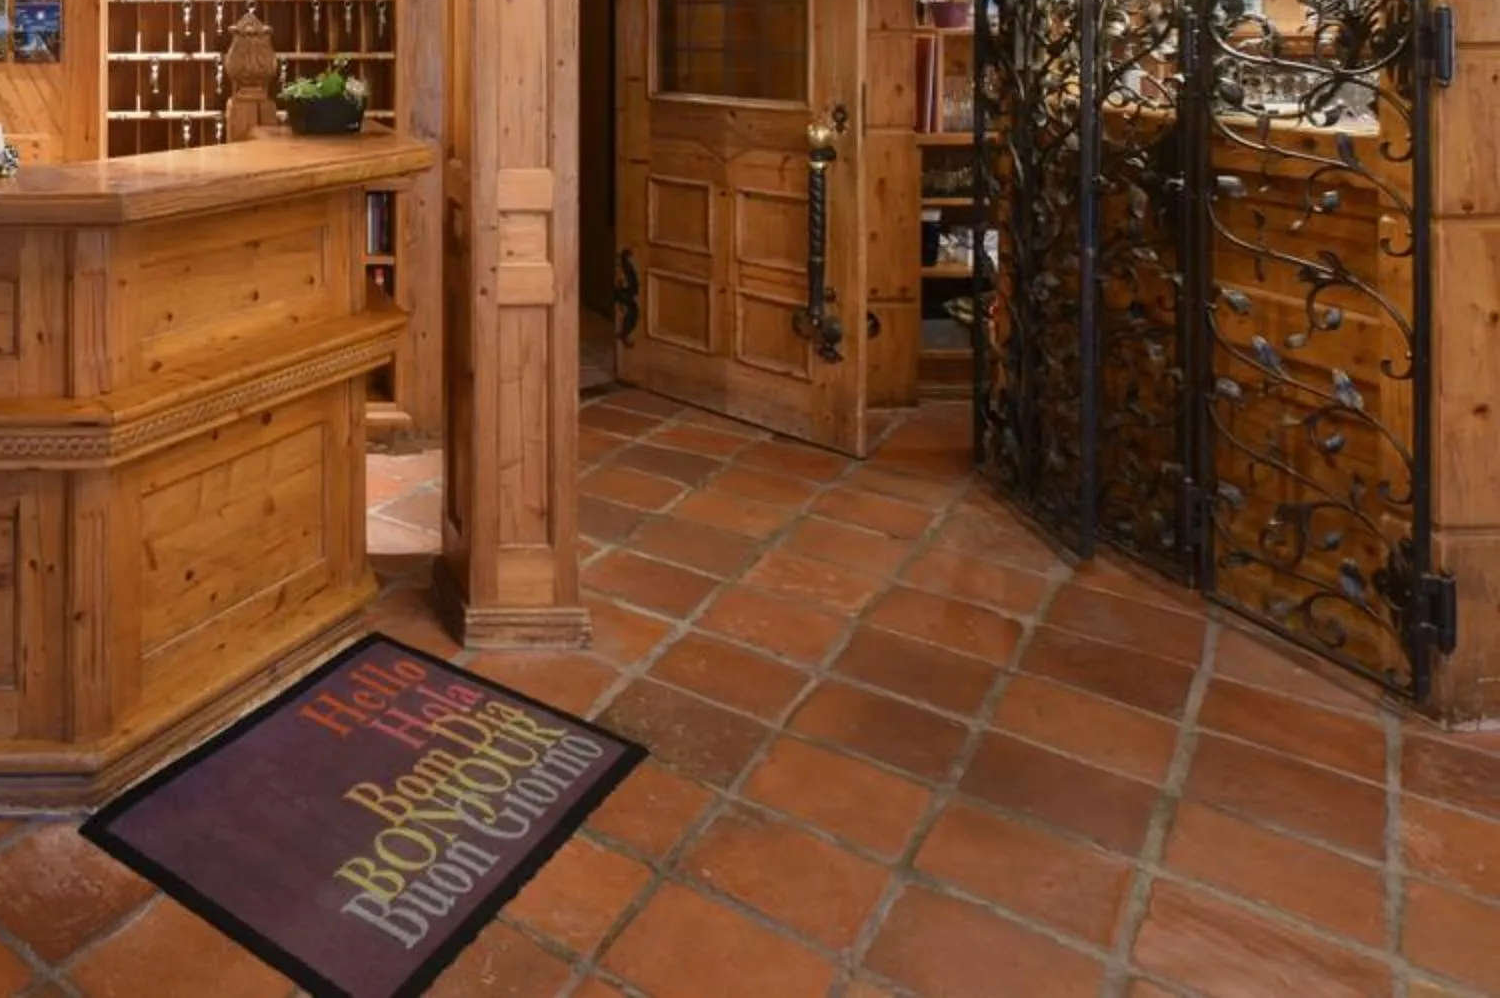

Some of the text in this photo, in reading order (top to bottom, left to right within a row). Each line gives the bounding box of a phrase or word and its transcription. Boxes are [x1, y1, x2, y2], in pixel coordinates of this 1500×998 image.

[302, 658, 426, 736] Hello
[372, 683, 485, 748] Hola
[332, 712, 568, 901] BONJOUR
[342, 700, 526, 826] Bom Dia
[340, 735, 604, 950] Buon Giorno
